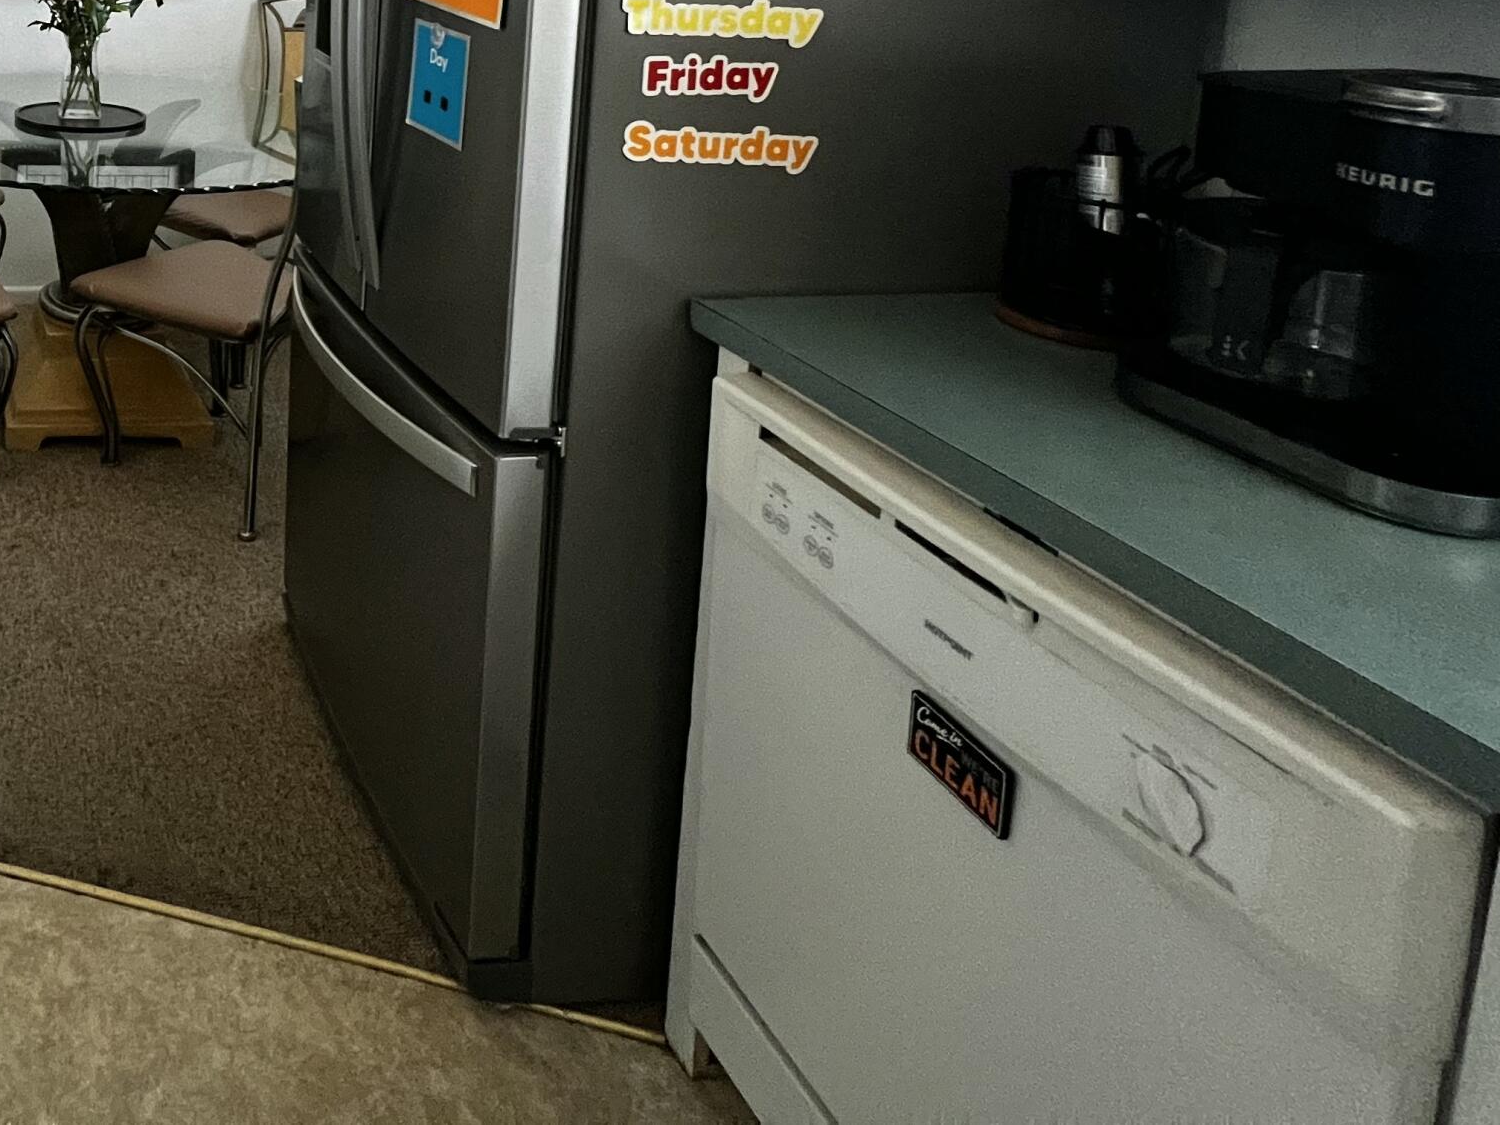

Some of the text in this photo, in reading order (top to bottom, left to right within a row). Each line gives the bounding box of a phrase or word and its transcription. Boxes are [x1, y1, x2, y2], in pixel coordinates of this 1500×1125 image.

[430, 47, 448, 73] Day
[646, 57, 775, 99] Friday
[627, 124, 815, 171] Saturday
[1335, 162, 1436, 197] KEURIG
[916, 706, 963, 748] Come in
[914, 728, 998, 825] CLEAN
